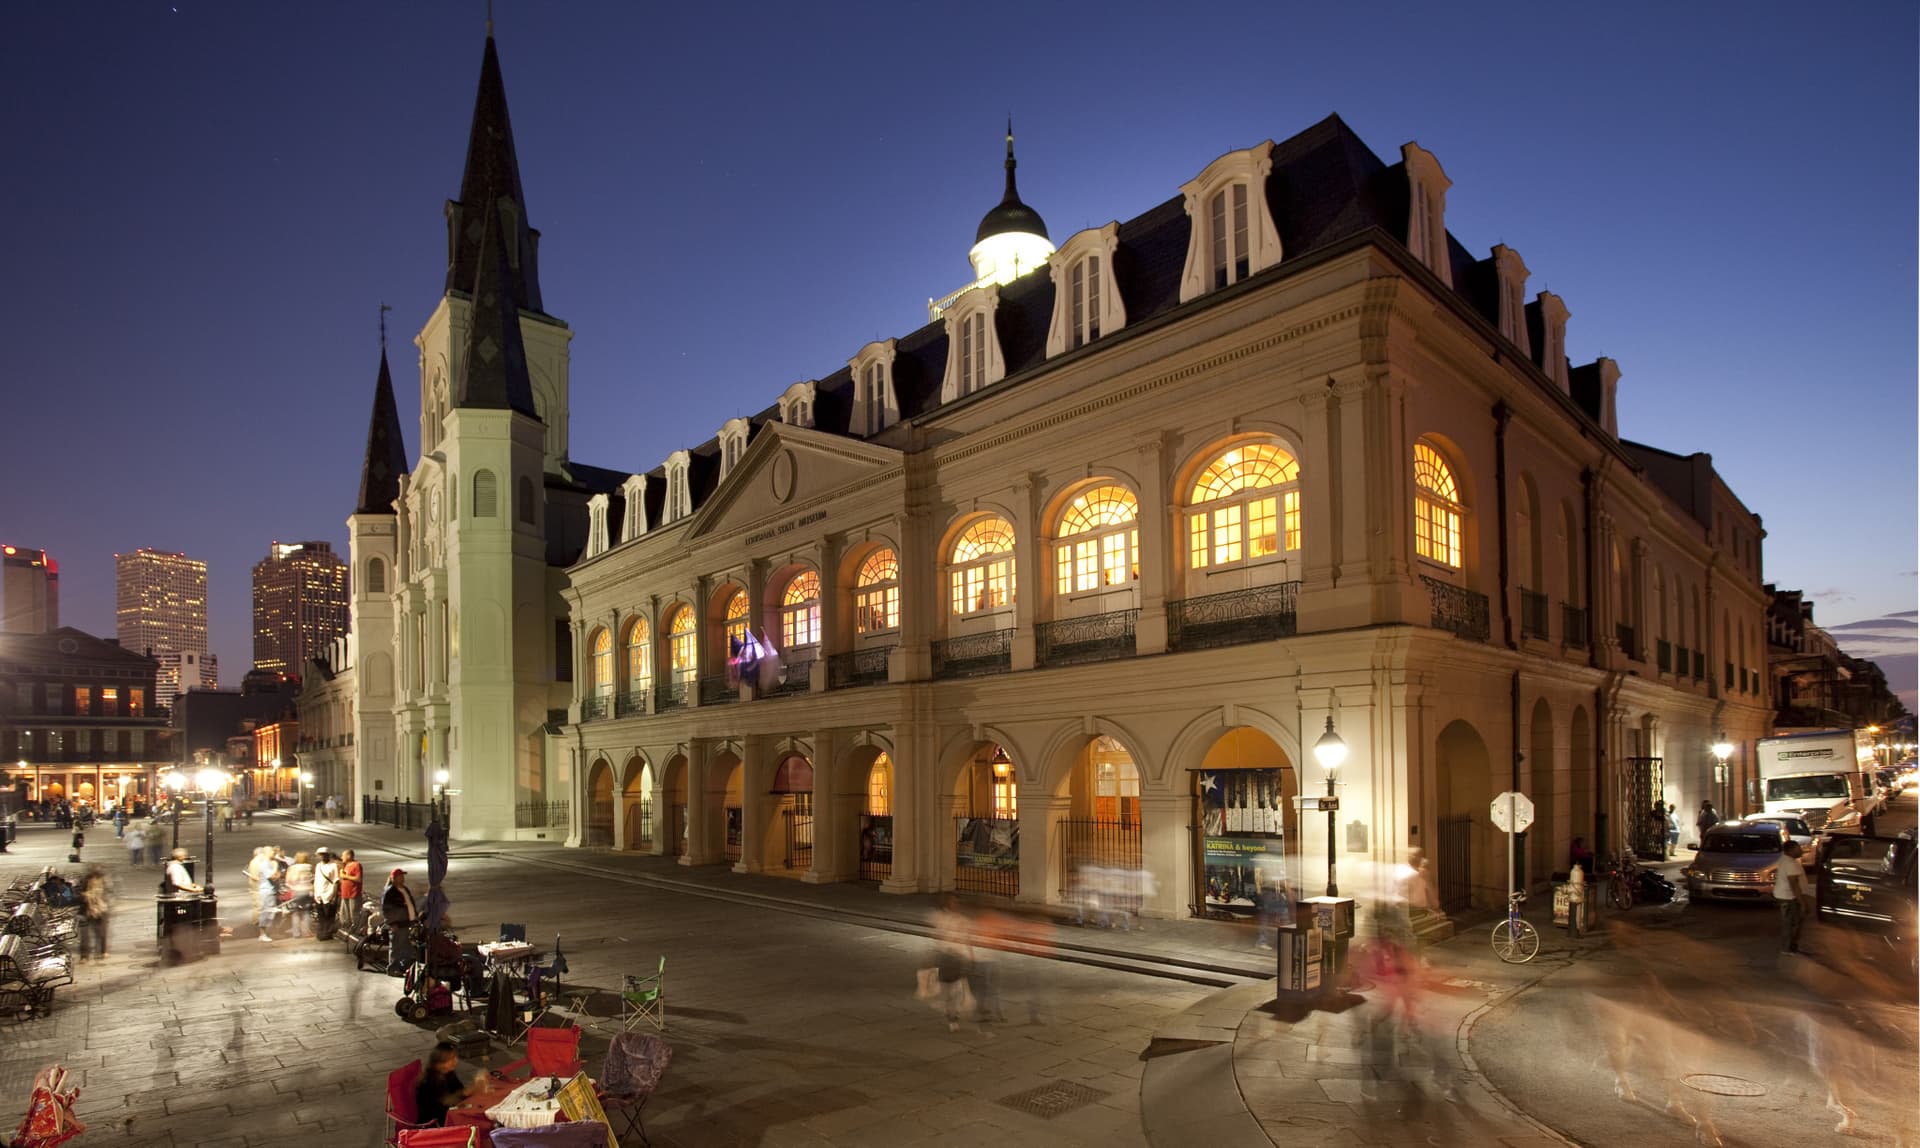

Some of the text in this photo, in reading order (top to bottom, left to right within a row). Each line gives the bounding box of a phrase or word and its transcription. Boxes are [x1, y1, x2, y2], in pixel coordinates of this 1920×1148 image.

[745, 510, 827, 545] LOUISIANA STATE MUSEUM
[1242, 844, 1265, 852] beyond
